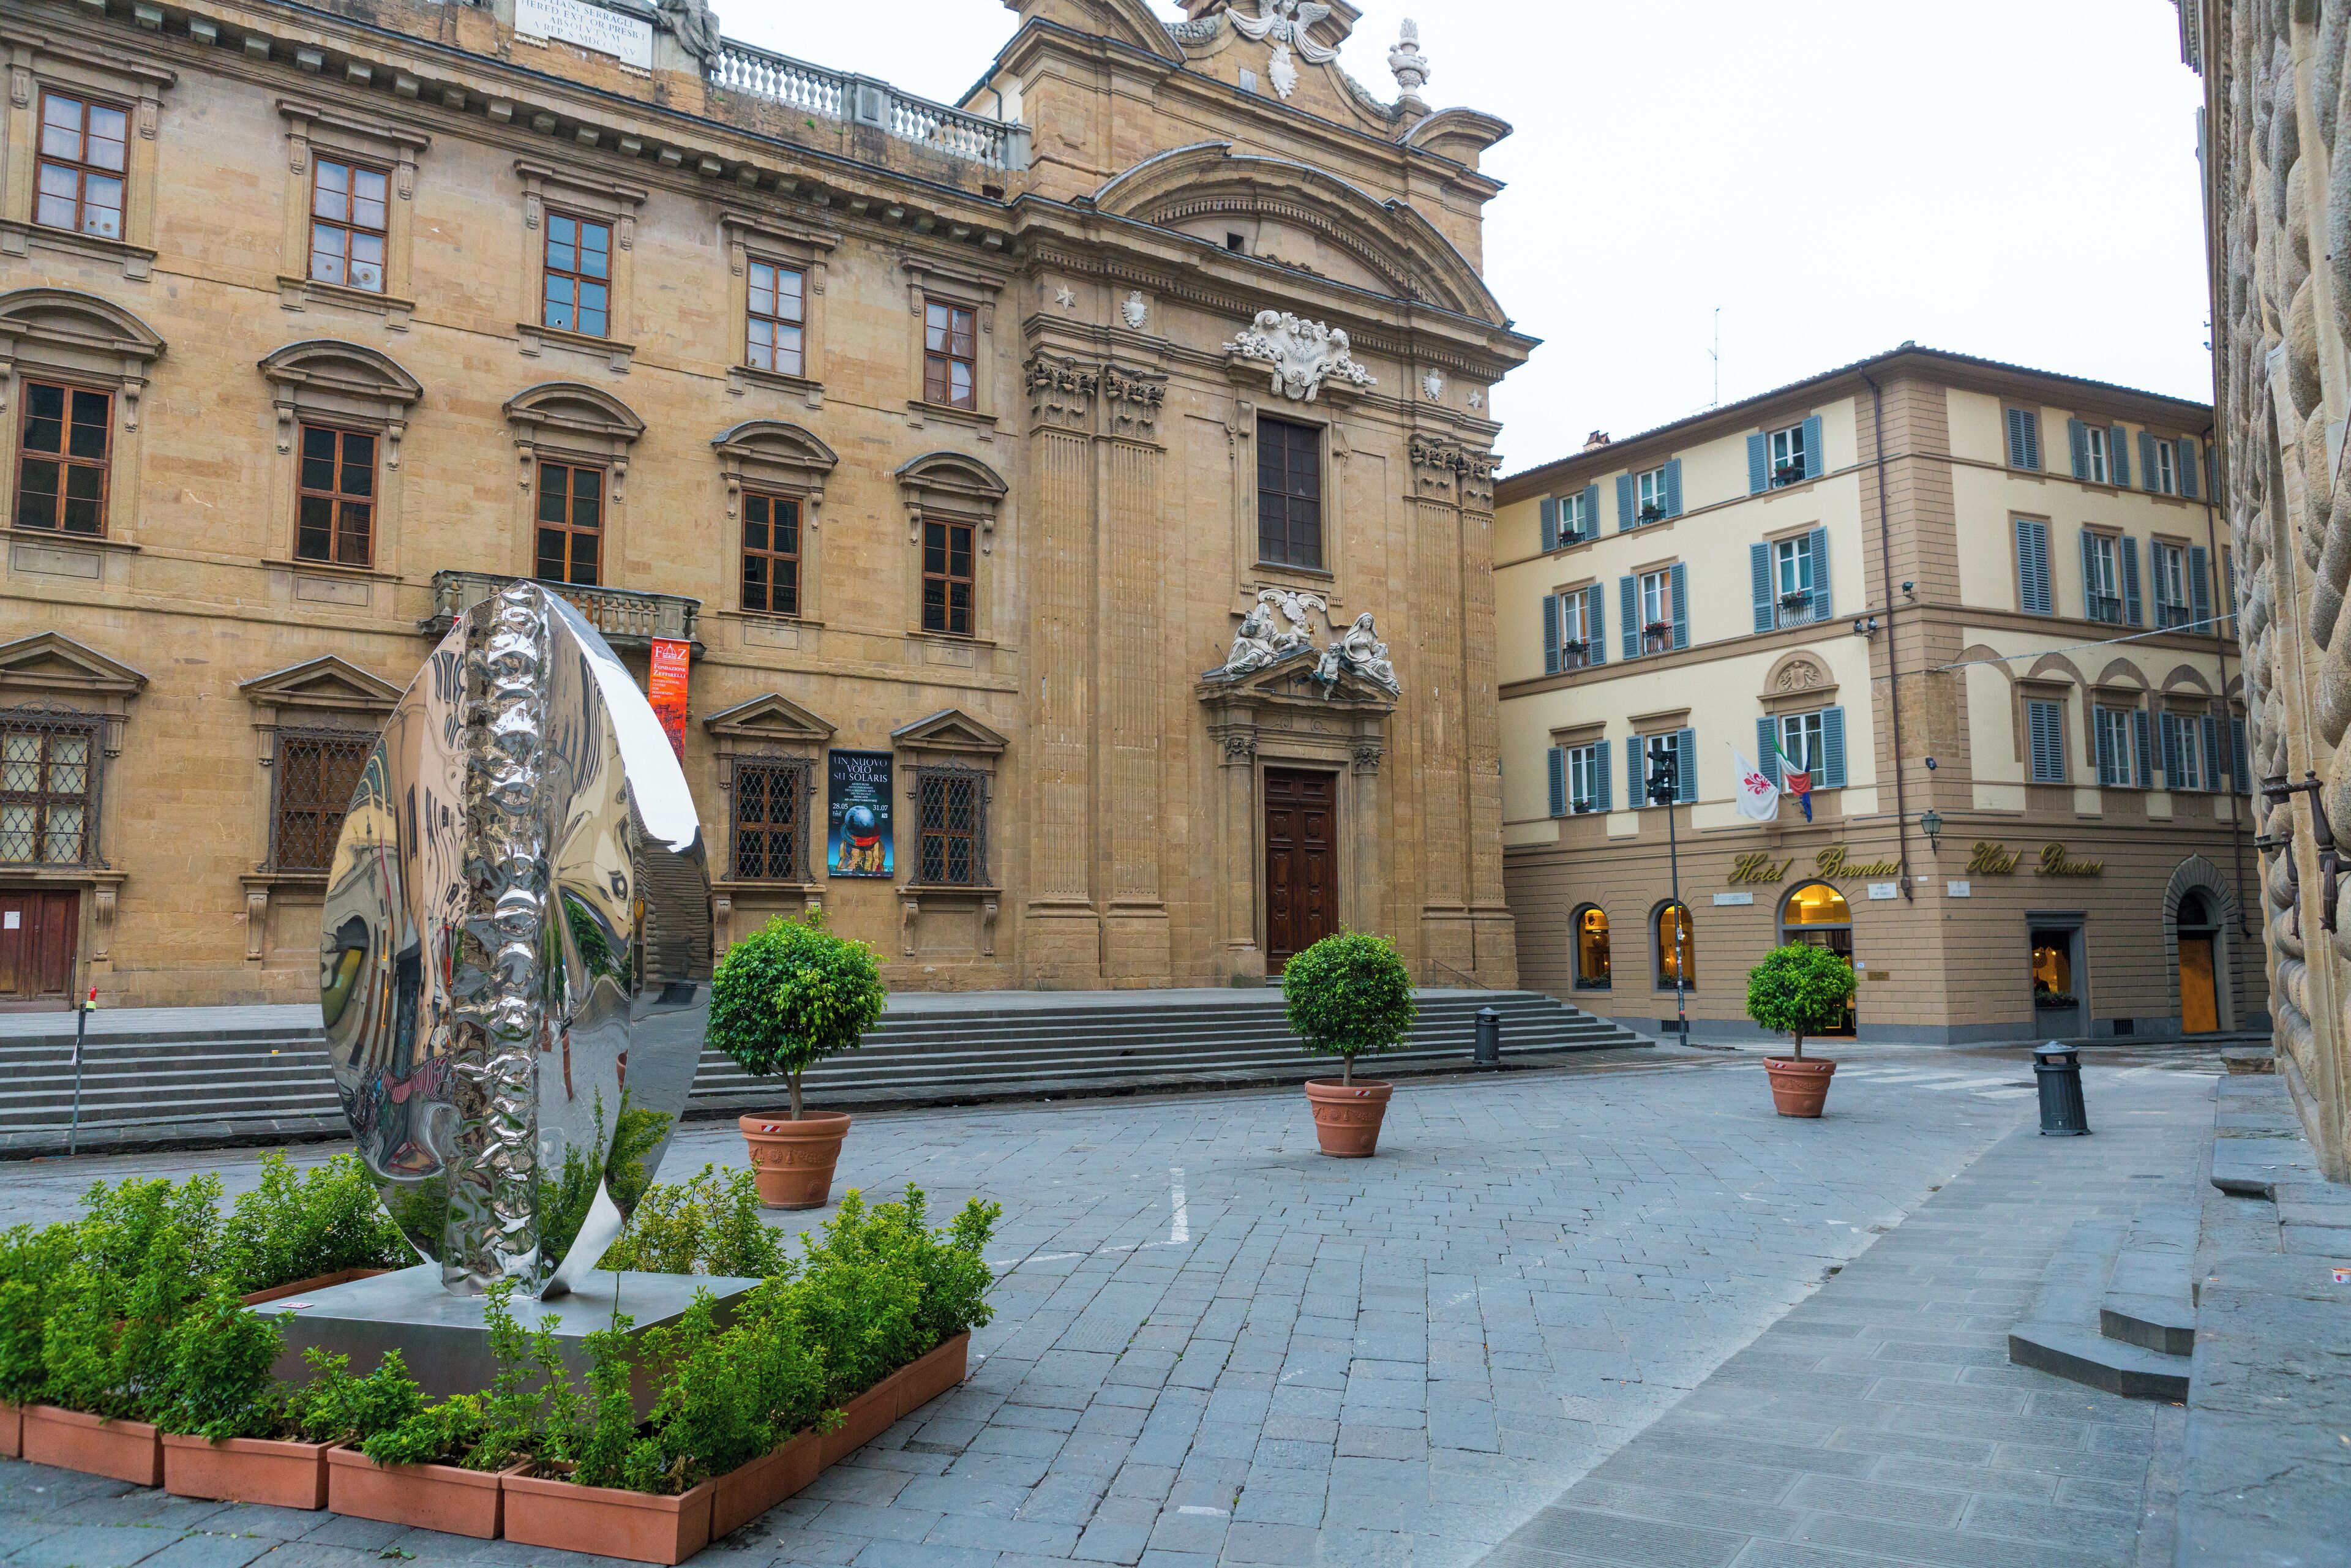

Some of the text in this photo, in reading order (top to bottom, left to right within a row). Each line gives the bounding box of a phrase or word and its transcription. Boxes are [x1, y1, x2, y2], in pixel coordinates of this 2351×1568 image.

[584, 7, 632, 28] SERRAGLI
[550, 17, 620, 43] ABSOLVTVM
[653, 663, 686, 672] FONDAZIONE
[653, 669, 686, 678] ZEFFIRELLI
[852, 757, 887, 767] NUOVO
[847, 765, 872, 774] VOLO
[849, 773, 888, 782] SOLARIS
[1966, 842, 2104, 874] Hotel Bernini
[1727, 846, 1902, 882] Hotel Bernini
